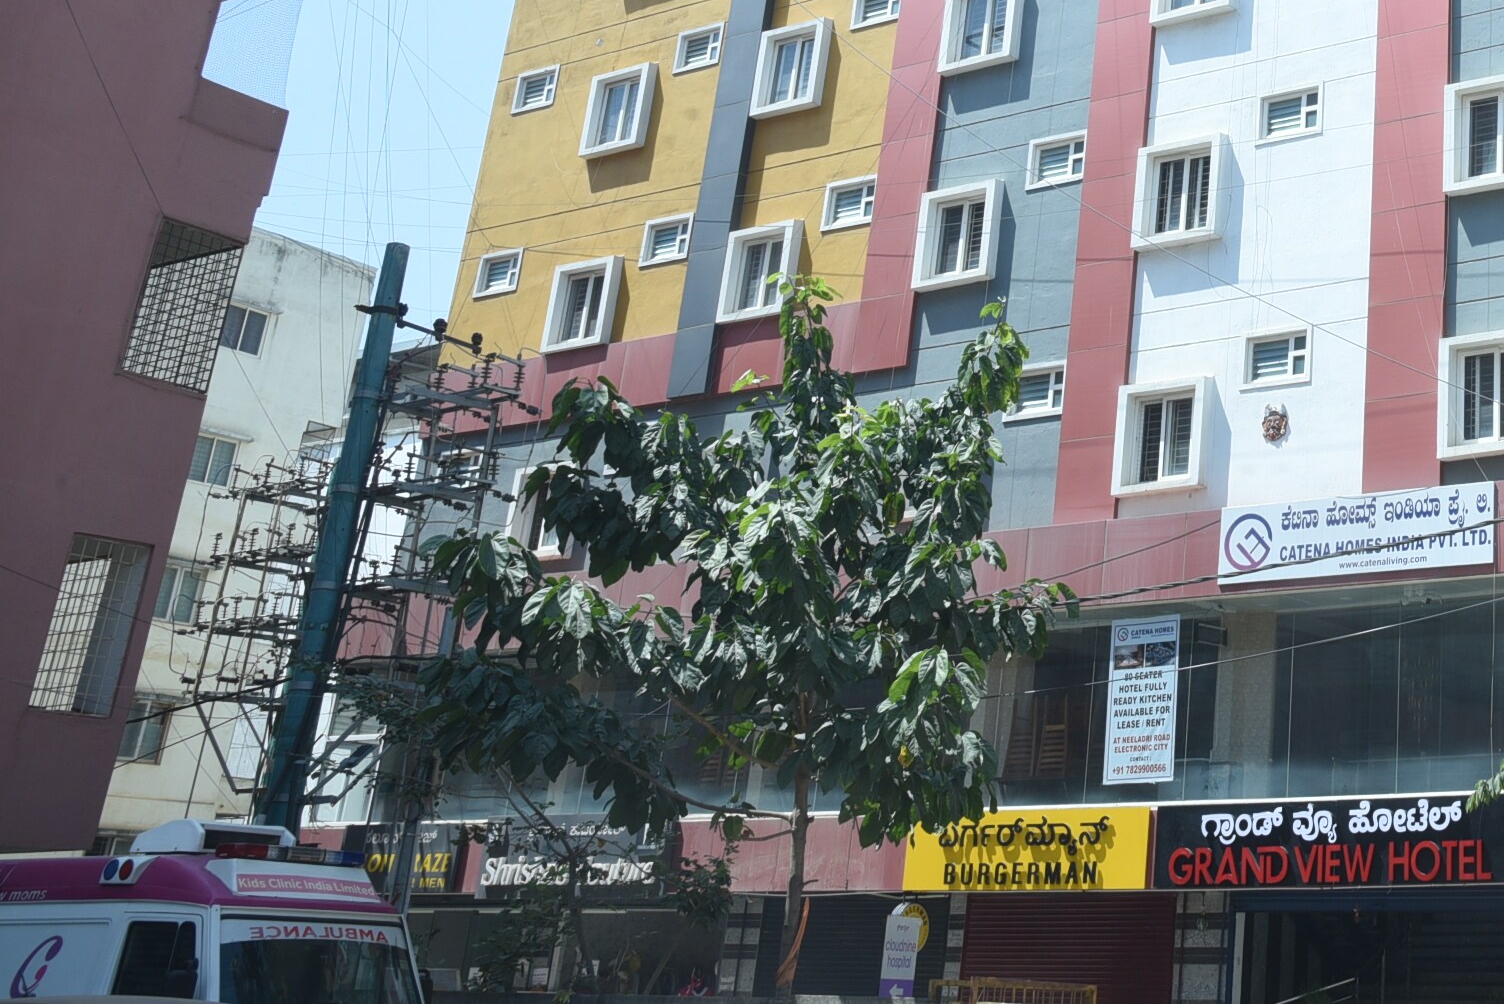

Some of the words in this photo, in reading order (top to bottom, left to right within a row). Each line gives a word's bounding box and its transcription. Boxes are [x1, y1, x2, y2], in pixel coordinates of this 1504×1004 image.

[1280, 542, 1330, 562] CATENA
[1336, 538, 1382, 556] HOMES
[1387, 534, 1424, 553] INDIA
[1429, 531, 1457, 549] PVT.
[1462, 529, 1491, 547] LTD.
[1339, 555, 1427, 569] www.catenaliving.com
[1131, 628, 1153, 636] CATENA
[1155, 626, 1174, 634] HOMES
[1135, 670, 1162, 680] SEATER
[1119, 684, 1142, 694] HOTEL
[1145, 682, 1167, 692] FULLY
[1113, 696, 1137, 706] READY
[1140, 693, 1172, 704] KITCHEN
[1114, 706, 1154, 718] AVAILABLE
[1156, 705, 1170, 715] FOR
[1117, 719, 1140, 729] LEASE
[1146, 718, 1166, 727] RENT
[1122, 735, 1152, 744] NEELADRI
[1154, 734, 1170, 742] ROAD
[1114, 744, 1152, 753] ELECTRONIC
[1154, 743, 1168, 751] CITY
[1113, 765, 1123, 775] +91
[1126, 764, 1166, 774] 7829900566
[1348, 798, 1462, 834] ಹೋಟೆಲ್
[1168, 845, 1289, 885] GRAND
[1294, 841, 1375, 884] VIEW
[1388, 839, 1492, 882] HOTEL
[943, 861, 1099, 885] BURGERMAN
[237, 877, 267, 889] Kids
[268, 878, 301, 890] Clinic
[305, 879, 333, 892] India
[333, 882, 375, 896] Limited
[8, 889, 47, 901] moms
[886, 939, 916, 953] cloudnine
[887, 955, 911, 971] hospital
